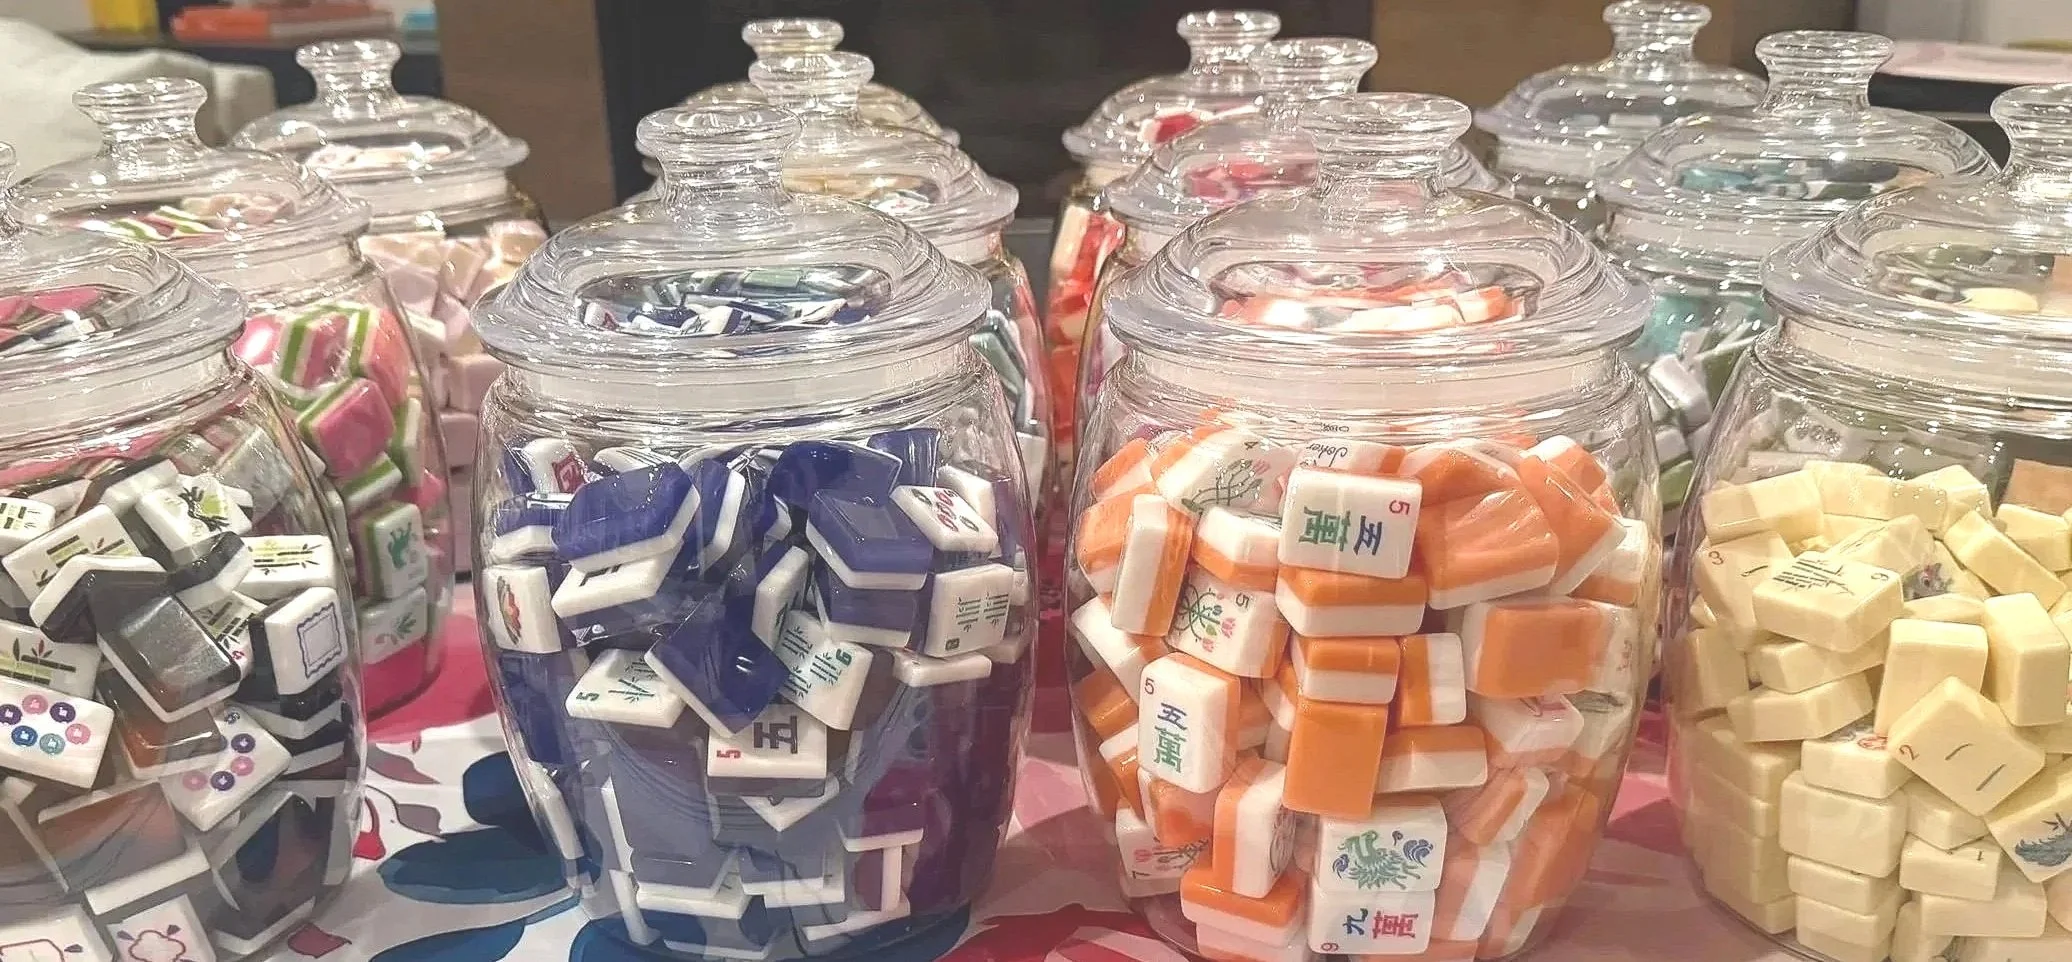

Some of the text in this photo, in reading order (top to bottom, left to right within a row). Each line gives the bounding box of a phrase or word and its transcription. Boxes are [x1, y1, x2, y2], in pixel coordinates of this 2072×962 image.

[1305, 442, 1348, 468] Joker
[1388, 499, 1410, 515] 5
[1298, 506, 1383, 556] 五萬
[1708, 550, 1724, 566] 3
[1235, 592, 1250, 609] 5
[835, 648, 852, 666] 6
[1144, 677, 1155, 695] 5
[576, 691, 600, 702] 5
[1153, 702, 1188, 774] 五萬
[716, 749, 741, 759] 5
[1898, 744, 1920, 761] 2
[1342, 907, 1419, 939] 九萬
